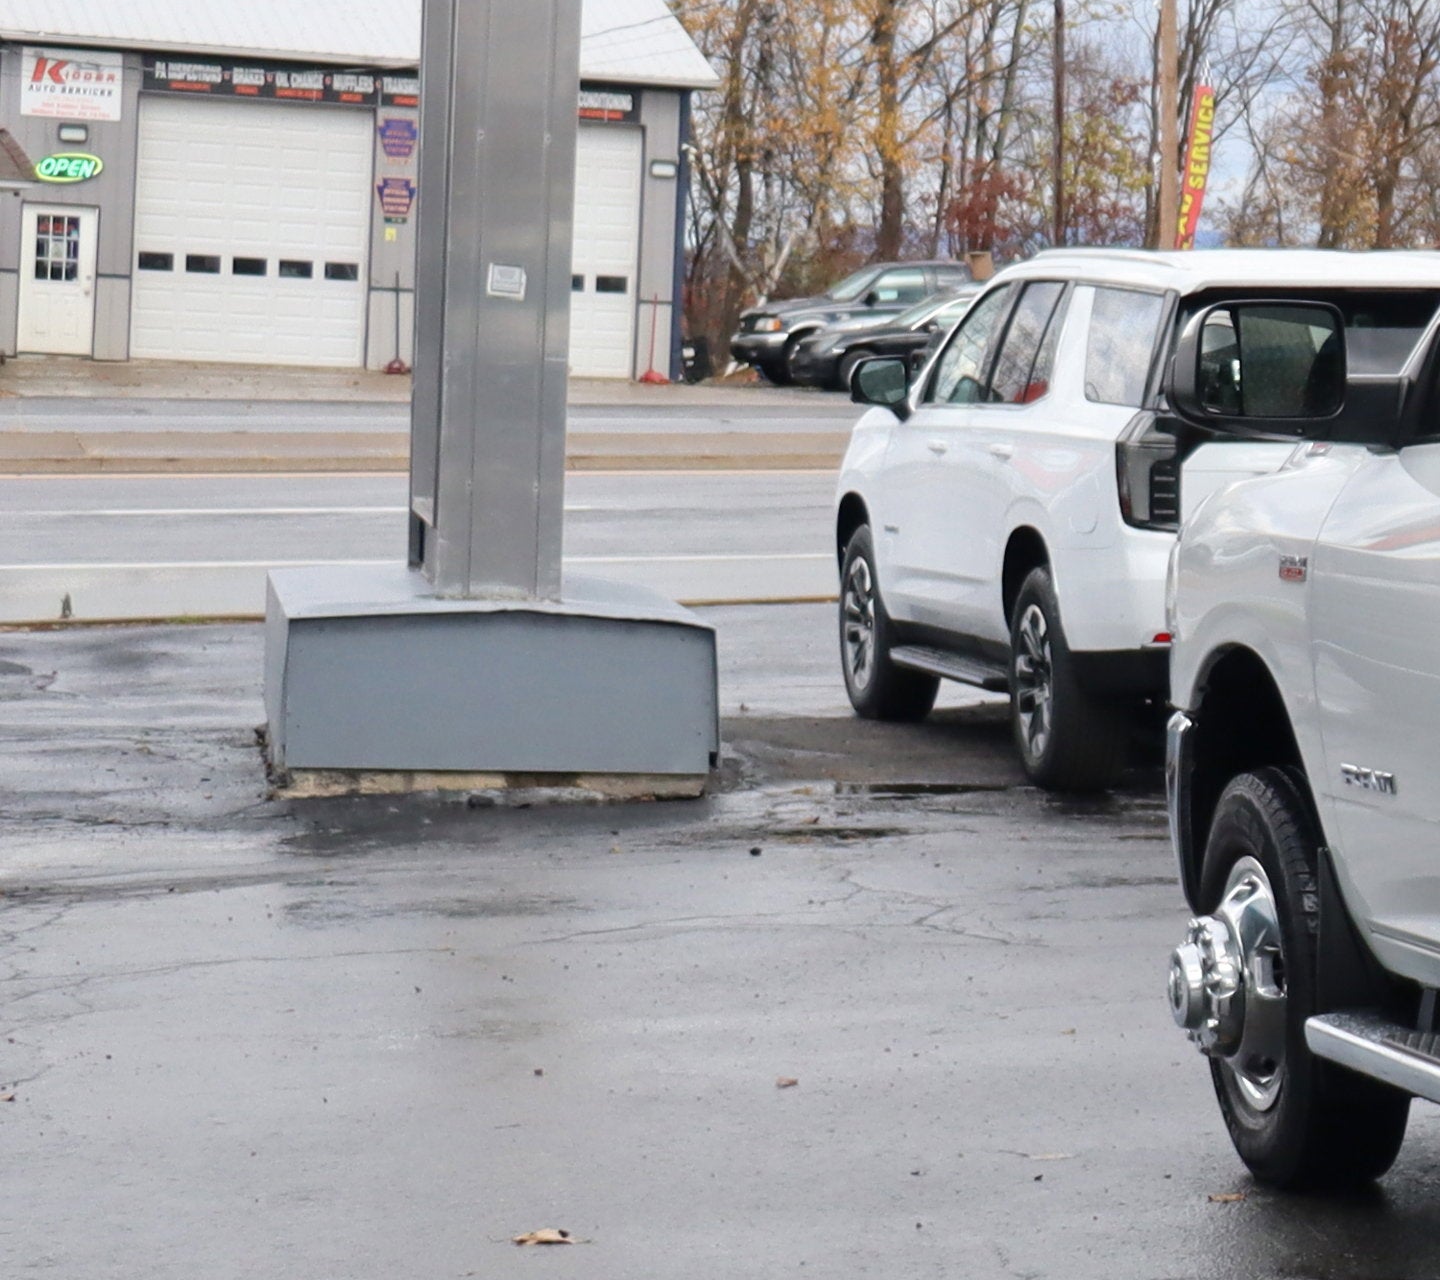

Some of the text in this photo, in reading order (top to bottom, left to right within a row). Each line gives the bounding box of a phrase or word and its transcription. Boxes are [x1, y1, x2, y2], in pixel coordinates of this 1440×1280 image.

[28, 83, 56, 93] AUTO
[1189, 93, 1214, 190] SERVICE
[40, 156, 97, 179] OPEN
